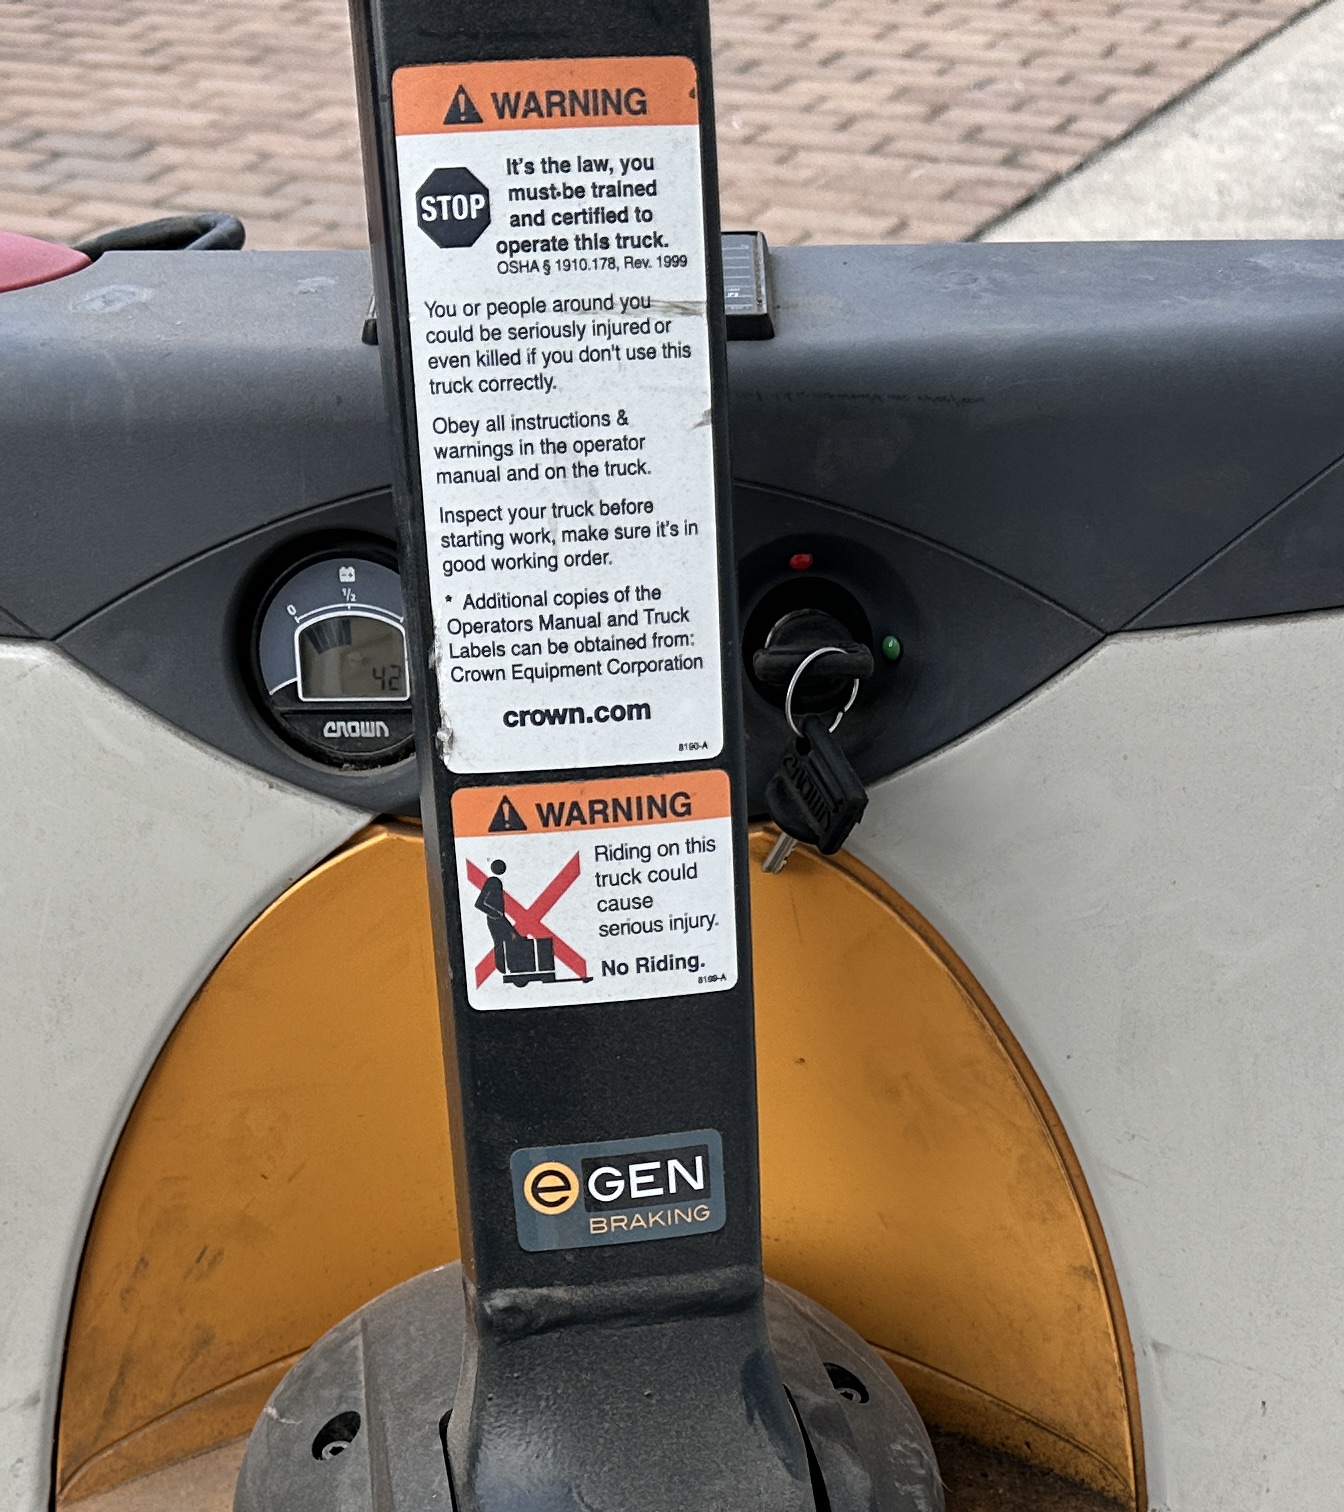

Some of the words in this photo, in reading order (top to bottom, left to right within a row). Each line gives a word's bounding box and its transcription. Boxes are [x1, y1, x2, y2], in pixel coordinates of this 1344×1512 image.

[490, 87, 647, 120] WARNING
[506, 158, 535, 176] It's
[540, 156, 571, 174] the
[577, 156, 614, 175] law,
[620, 157, 654, 176] you
[591, 179, 657, 198] trained
[421, 194, 485, 222] STOP
[510, 209, 545, 228] and
[551, 206, 629, 226] certified
[634, 206, 653, 223] to
[496, 236, 569, 258] operate
[574, 233, 610, 251] this
[615, 231, 669, 249] truck.
[497, 260, 540, 274] OSHA
[555, 257, 619, 272] 1910.178,
[624, 256, 652, 269] Rev.
[657, 254, 688, 268] 1999
[424, 301, 457, 318] You
[463, 303, 481, 316] or
[487, 297, 547, 320] people
[552, 293, 614, 313] around
[619, 296, 651, 314] you
[426, 325, 474, 344] could
[480, 324, 502, 341] be
[508, 320, 586, 342] seriously
[592, 317, 651, 340] injured
[654, 320, 672, 334] or
[428, 355, 470, 369] even
[476, 348, 521, 367] killed
[527, 347, 537, 365] if
[541, 350, 573, 369] you
[579, 344, 621, 363] don't
[626, 346, 657, 360] use
[661, 341, 691, 359] this
[429, 376, 473, 395] truck
[478, 373, 556, 394] correctly.
[433, 417, 480, 437] Obey
[486, 415, 505, 432] all
[511, 411, 611, 431] instructions
[617, 409, 629, 426] &
[434, 443, 514, 461] warnings
[519, 439, 534, 455] in
[539, 438, 567, 455] the
[573, 435, 646, 457] operator
[437, 465, 500, 484] manual
[507, 463, 539, 481] and
[545, 466, 566, 480] on
[572, 461, 599, 478] the
[604, 458, 651, 477] truck.
[440, 505, 503, 527] Inspect
[507, 506, 547, 525] your
[551, 500, 595, 519] truck
[599, 498, 654, 516] before
[441, 530, 504, 550] starting
[509, 527, 556, 546] work,
[562, 525, 609, 542] make
[614, 526, 651, 540] sure
[656, 520, 679, 537] it's
[684, 519, 698, 536] in
[443, 555, 486, 577] good
[491, 552, 558, 572] working
[564, 550, 612, 567] order.
[463, 590, 547, 610] Additional
[553, 588, 609, 609] copies
[614, 585, 630, 603] of
[635, 585, 661, 601] the
[447, 618, 533, 638] Operators
[539, 611, 601, 631] Manual
[607, 609, 638, 627] and
[643, 606, 690, 625] Truck
[449, 641, 506, 659] Labels
[511, 643, 542, 656] can
[547, 638, 569, 654] be
[574, 633, 647, 653] obtained
[652, 632, 694, 648] from:
[373, 664, 401, 691] 42
[451, 666, 506, 682] Crown
[512, 661, 602, 683] Equipment
[607, 654, 703, 677] Corporation
[503, 703, 651, 728] crown.com
[536, 792, 692, 828] WARNING
[595, 843, 651, 863] Riding
[657, 843, 679, 857] on
[685, 837, 716, 854] this
[595, 868, 642, 887] truck
[648, 862, 697, 883] could
[597, 896, 653, 912] cause
[599, 919, 663, 937] serious
[669, 914, 719, 934] injury.
[601, 960, 629, 977] No
[636, 954, 705, 974] Riding.
[587, 1155, 705, 1202] GEN
[589, 1204, 711, 1235] BRAKING
